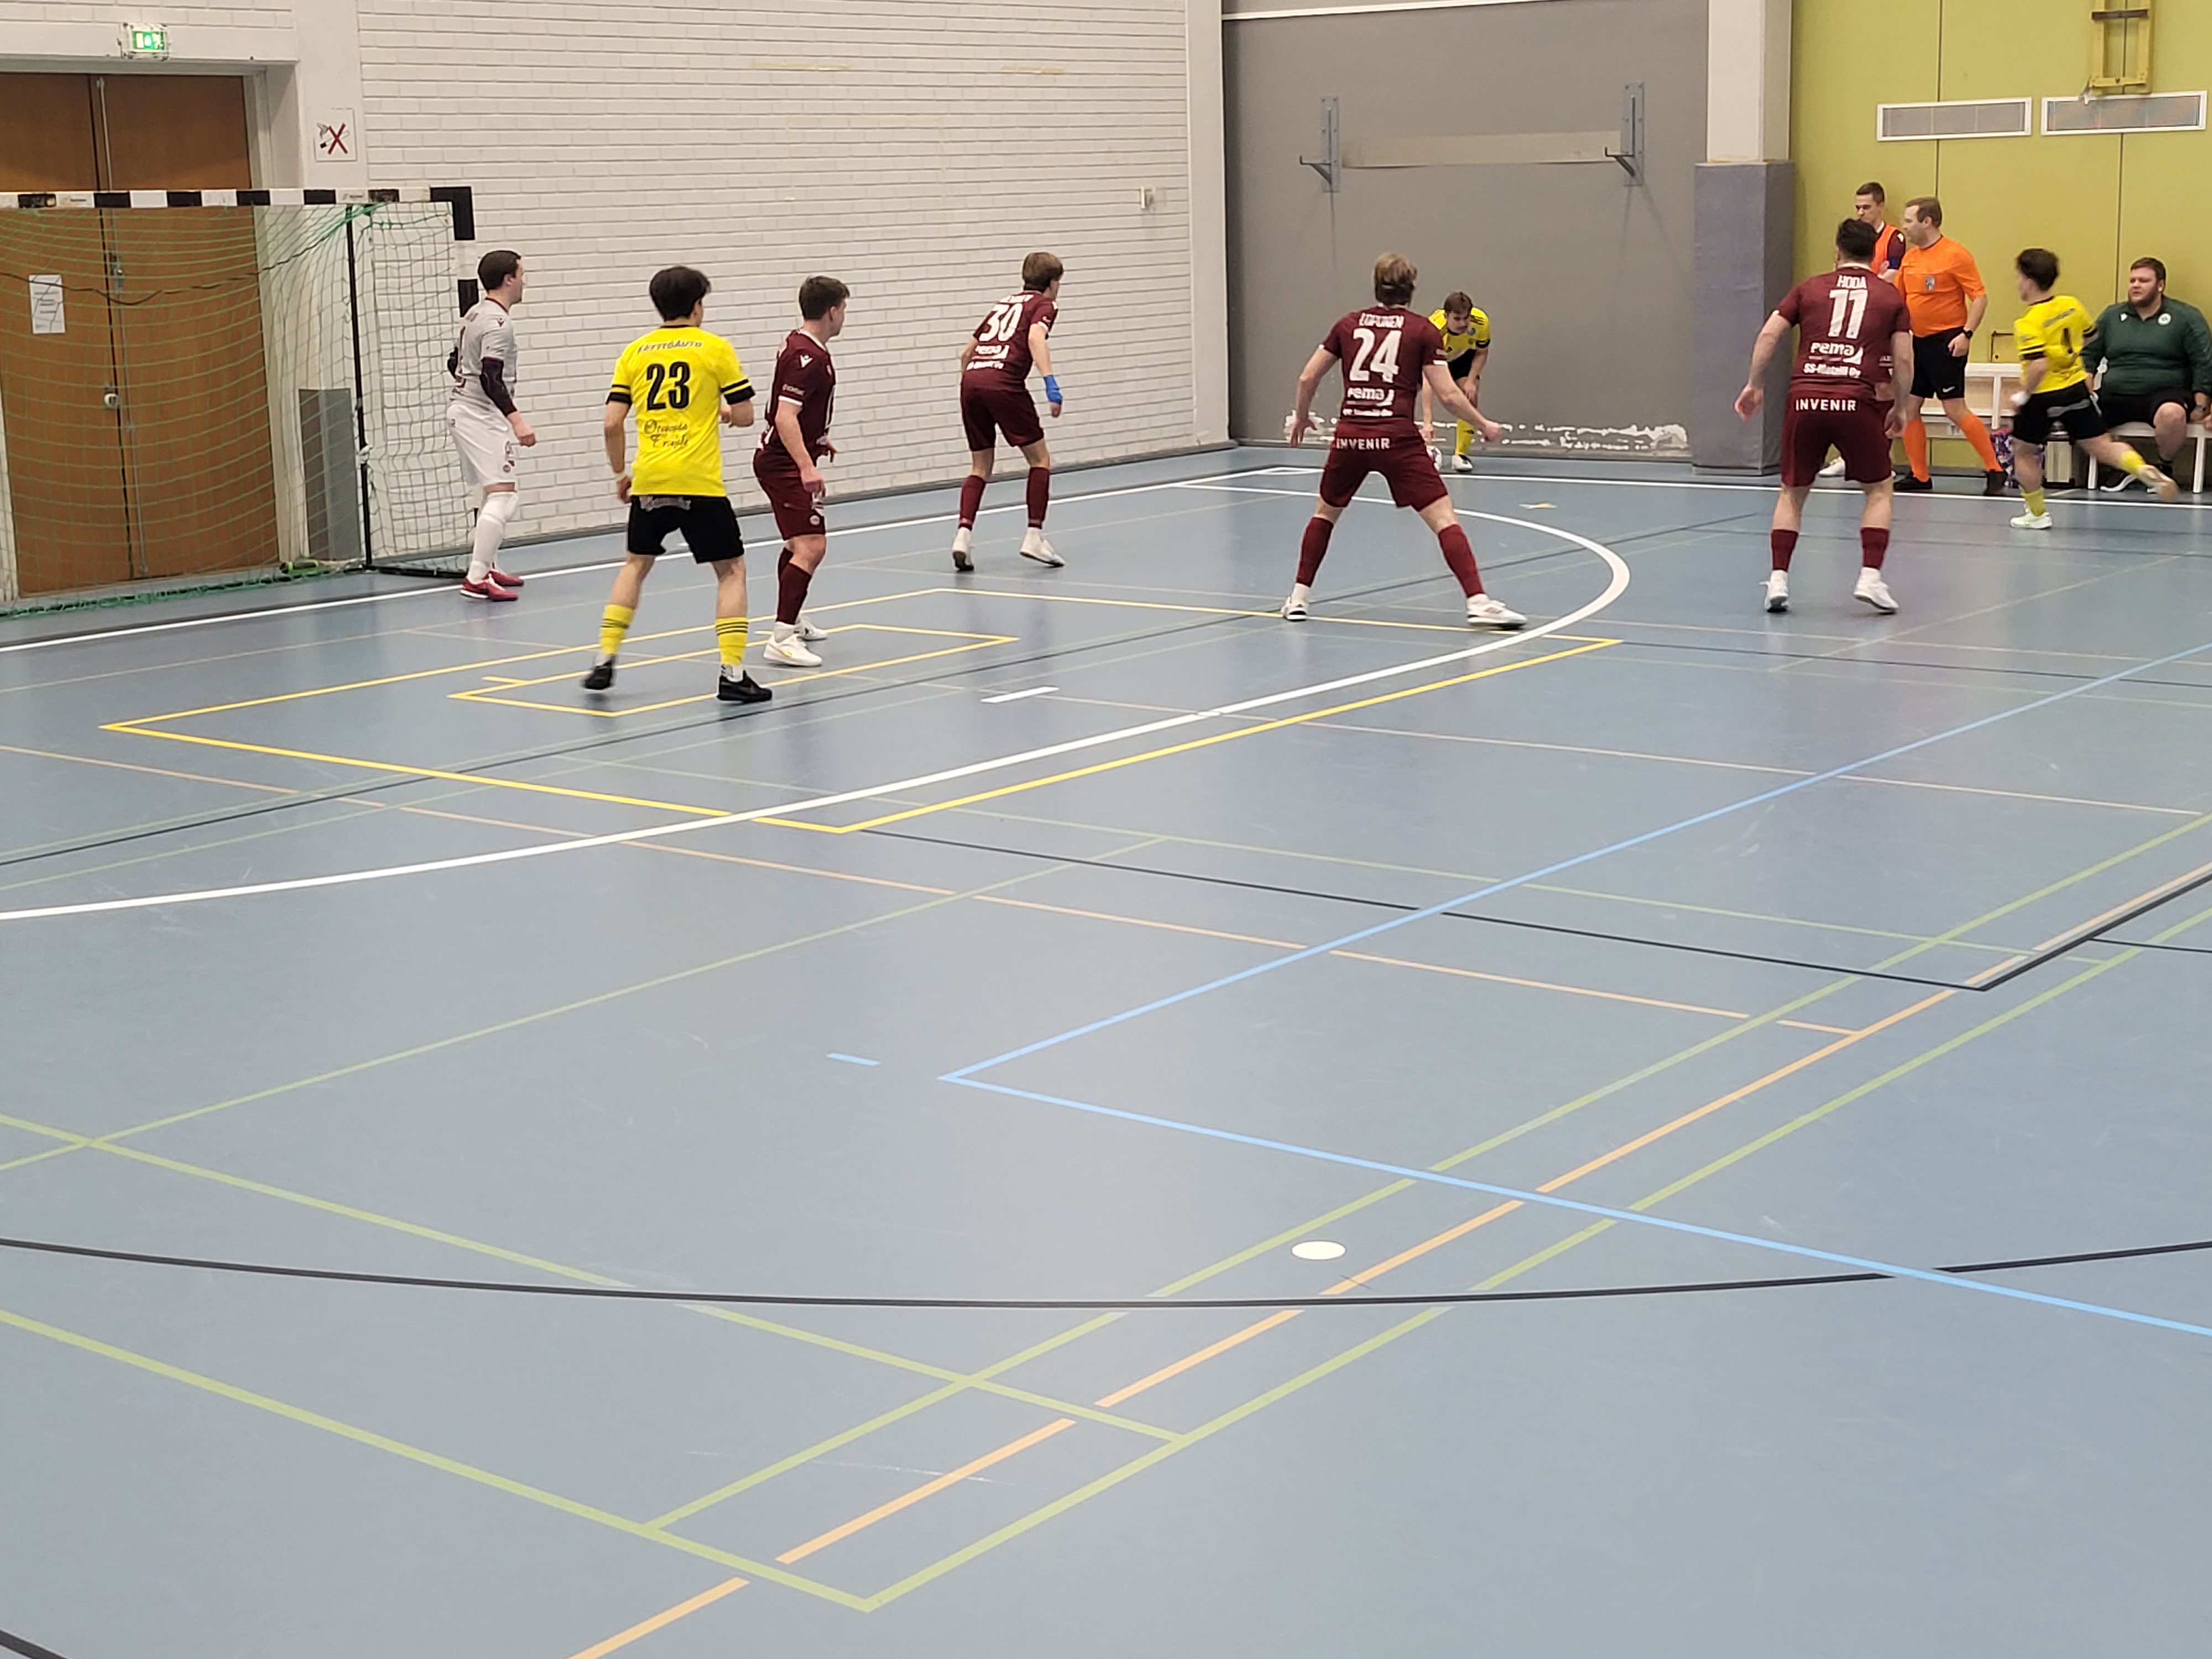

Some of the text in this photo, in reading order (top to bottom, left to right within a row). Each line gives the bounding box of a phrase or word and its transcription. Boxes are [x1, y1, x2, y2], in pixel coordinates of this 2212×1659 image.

[1837, 275, 1867, 289] HODA
[978, 303, 1023, 341] 30
[1828, 289, 1868, 339] 11
[1350, 327, 1402, 383] 24
[646, 361, 691, 410] 23
[1796, 398, 1856, 411] INVENIR
[1336, 437, 1390, 450] INVENIR
